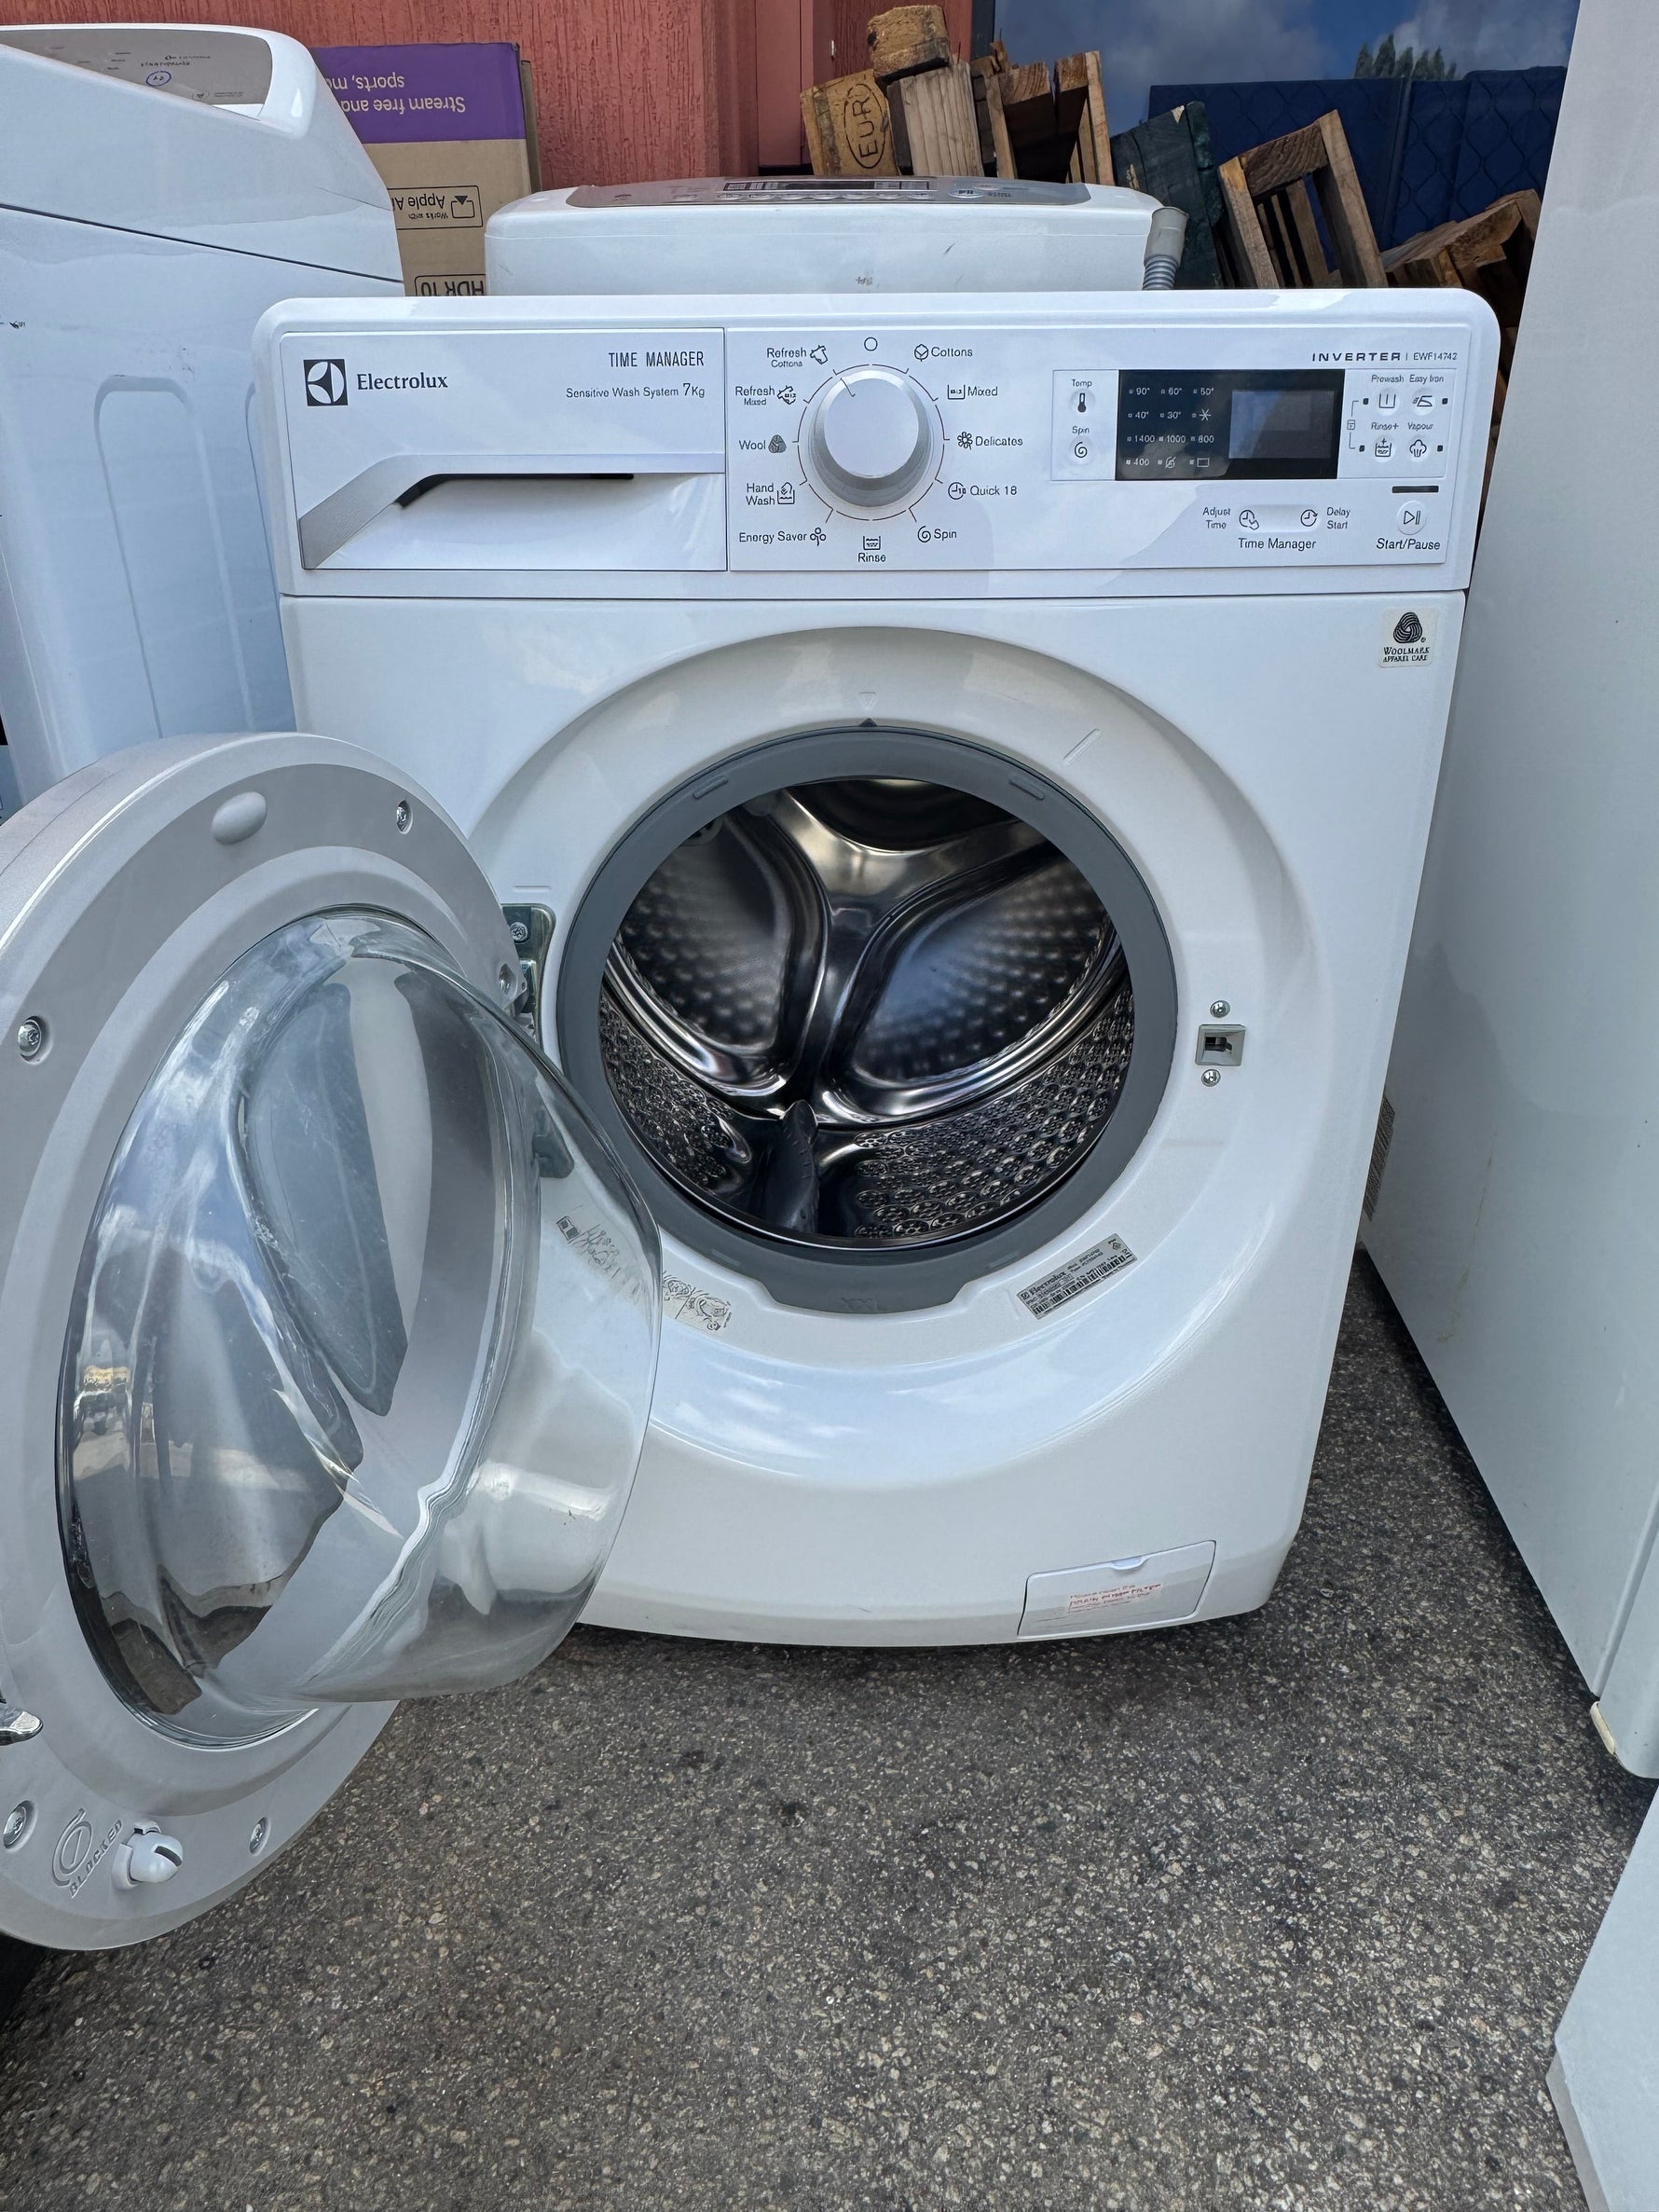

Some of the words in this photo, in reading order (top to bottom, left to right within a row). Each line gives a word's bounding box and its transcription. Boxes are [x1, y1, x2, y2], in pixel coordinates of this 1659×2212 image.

[352, 72, 404, 92] sports,
[374, 97, 404, 115] free
[409, 96, 466, 113] Stream
[407, 193, 445, 210] Apple
[426, 212, 448, 220] Works
[420, 282, 437, 296] 10
[445, 281, 485, 296] HDR
[767, 347, 807, 358] Refresh
[931, 347, 973, 358] Cottons
[1312, 351, 1401, 364] INVERTER
[1413, 352, 1458, 361] EWF14742
[609, 351, 638, 367] TIME
[646, 350, 705, 367] MANAGER
[771, 360, 802, 368] Cottons
[357, 373, 449, 391] Electrolux
[1071, 378, 1093, 389] Temp
[1371, 374, 1405, 383] Prewash
[1409, 374, 1428, 384] Easy
[566, 387, 610, 399] Sensitive
[611, 386, 640, 398] Wash
[643, 385, 679, 399] System
[682, 382, 706, 399] 7Kg
[735, 385, 775, 396] Refresh
[967, 385, 998, 397] Mixed
[1072, 425, 1090, 435] Spin
[1407, 421, 1433, 432] Vapour
[975, 435, 1023, 447] Delicates
[1134, 434, 1156, 443] 1400
[1167, 434, 1186, 444] 1000
[1198, 434, 1214, 444] 800
[739, 439, 766, 451] Wool
[1132, 458, 1150, 466] 400
[747, 483, 774, 494] Hand
[970, 485, 1000, 496] Quick
[1005, 485, 1018, 496] 18
[746, 495, 775, 506] Wash
[1202, 506, 1231, 518] Adjust
[1326, 506, 1351, 517] Delay
[1205, 519, 1227, 529] Time
[1326, 520, 1348, 529] Start
[739, 531, 775, 544] Energy
[777, 531, 807, 542] Saver
[933, 529, 957, 541] Spin
[1238, 538, 1265, 549] Time
[1268, 538, 1316, 551] Manager
[1376, 537, 1441, 551] Start/Pause
[857, 552, 886, 563] Rinse
[68, 1820, 123, 1899] BLOCKED
